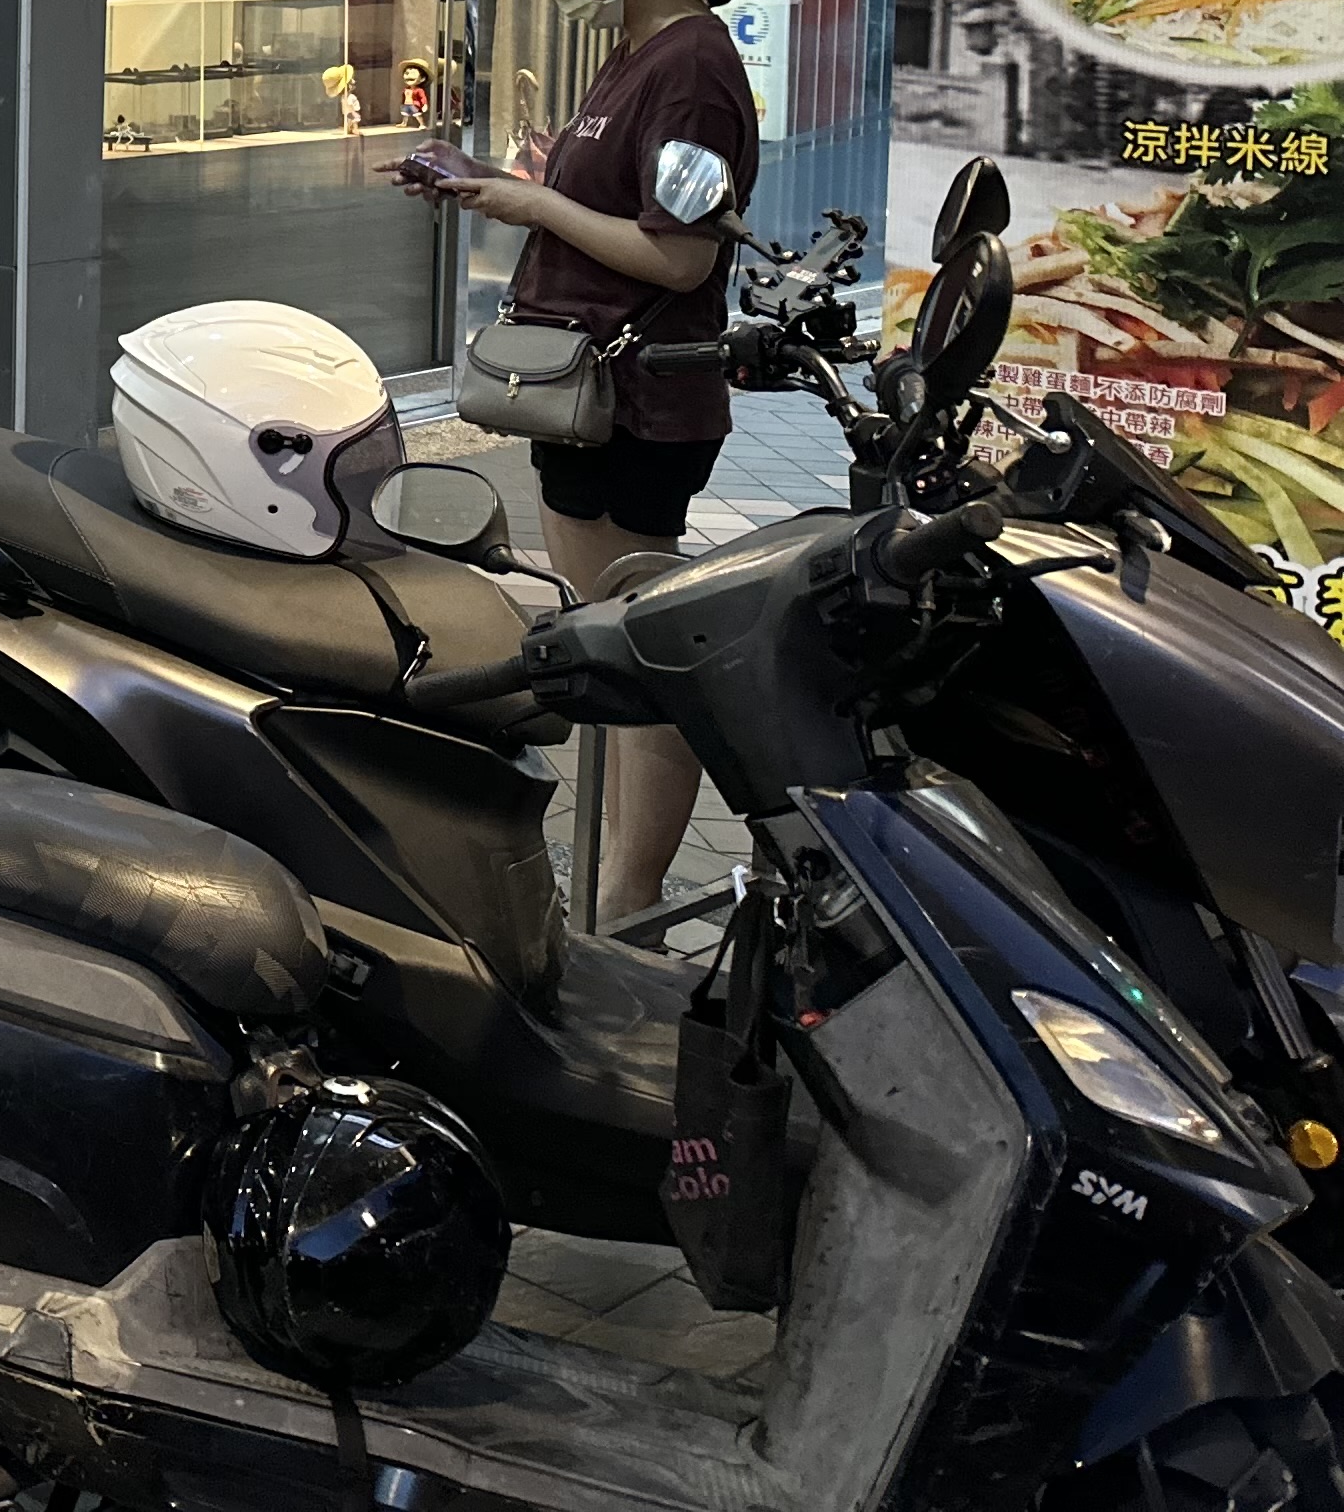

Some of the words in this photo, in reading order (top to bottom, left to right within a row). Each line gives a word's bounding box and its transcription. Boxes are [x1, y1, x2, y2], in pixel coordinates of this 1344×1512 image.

[1121, 120, 1330, 175] 涼拌米線
[1071, 1169, 1148, 1221] SYM
